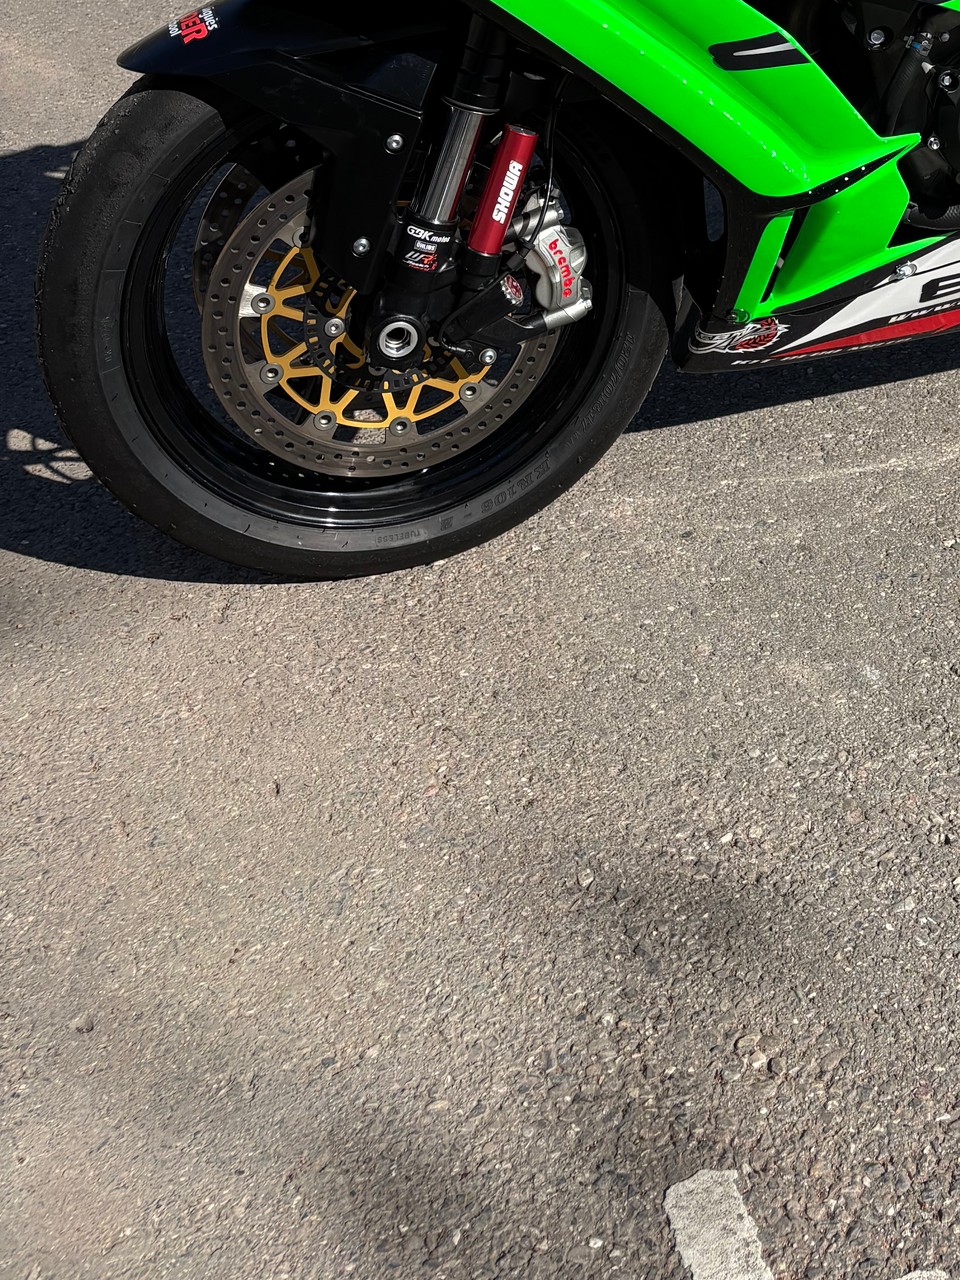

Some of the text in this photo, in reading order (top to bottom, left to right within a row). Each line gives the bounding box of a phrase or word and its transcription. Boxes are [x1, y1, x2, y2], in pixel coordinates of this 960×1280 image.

[492, 160, 523, 224] SHOWA
[407, 225, 434, 241] GBK
[548, 239, 573, 298] brembo
